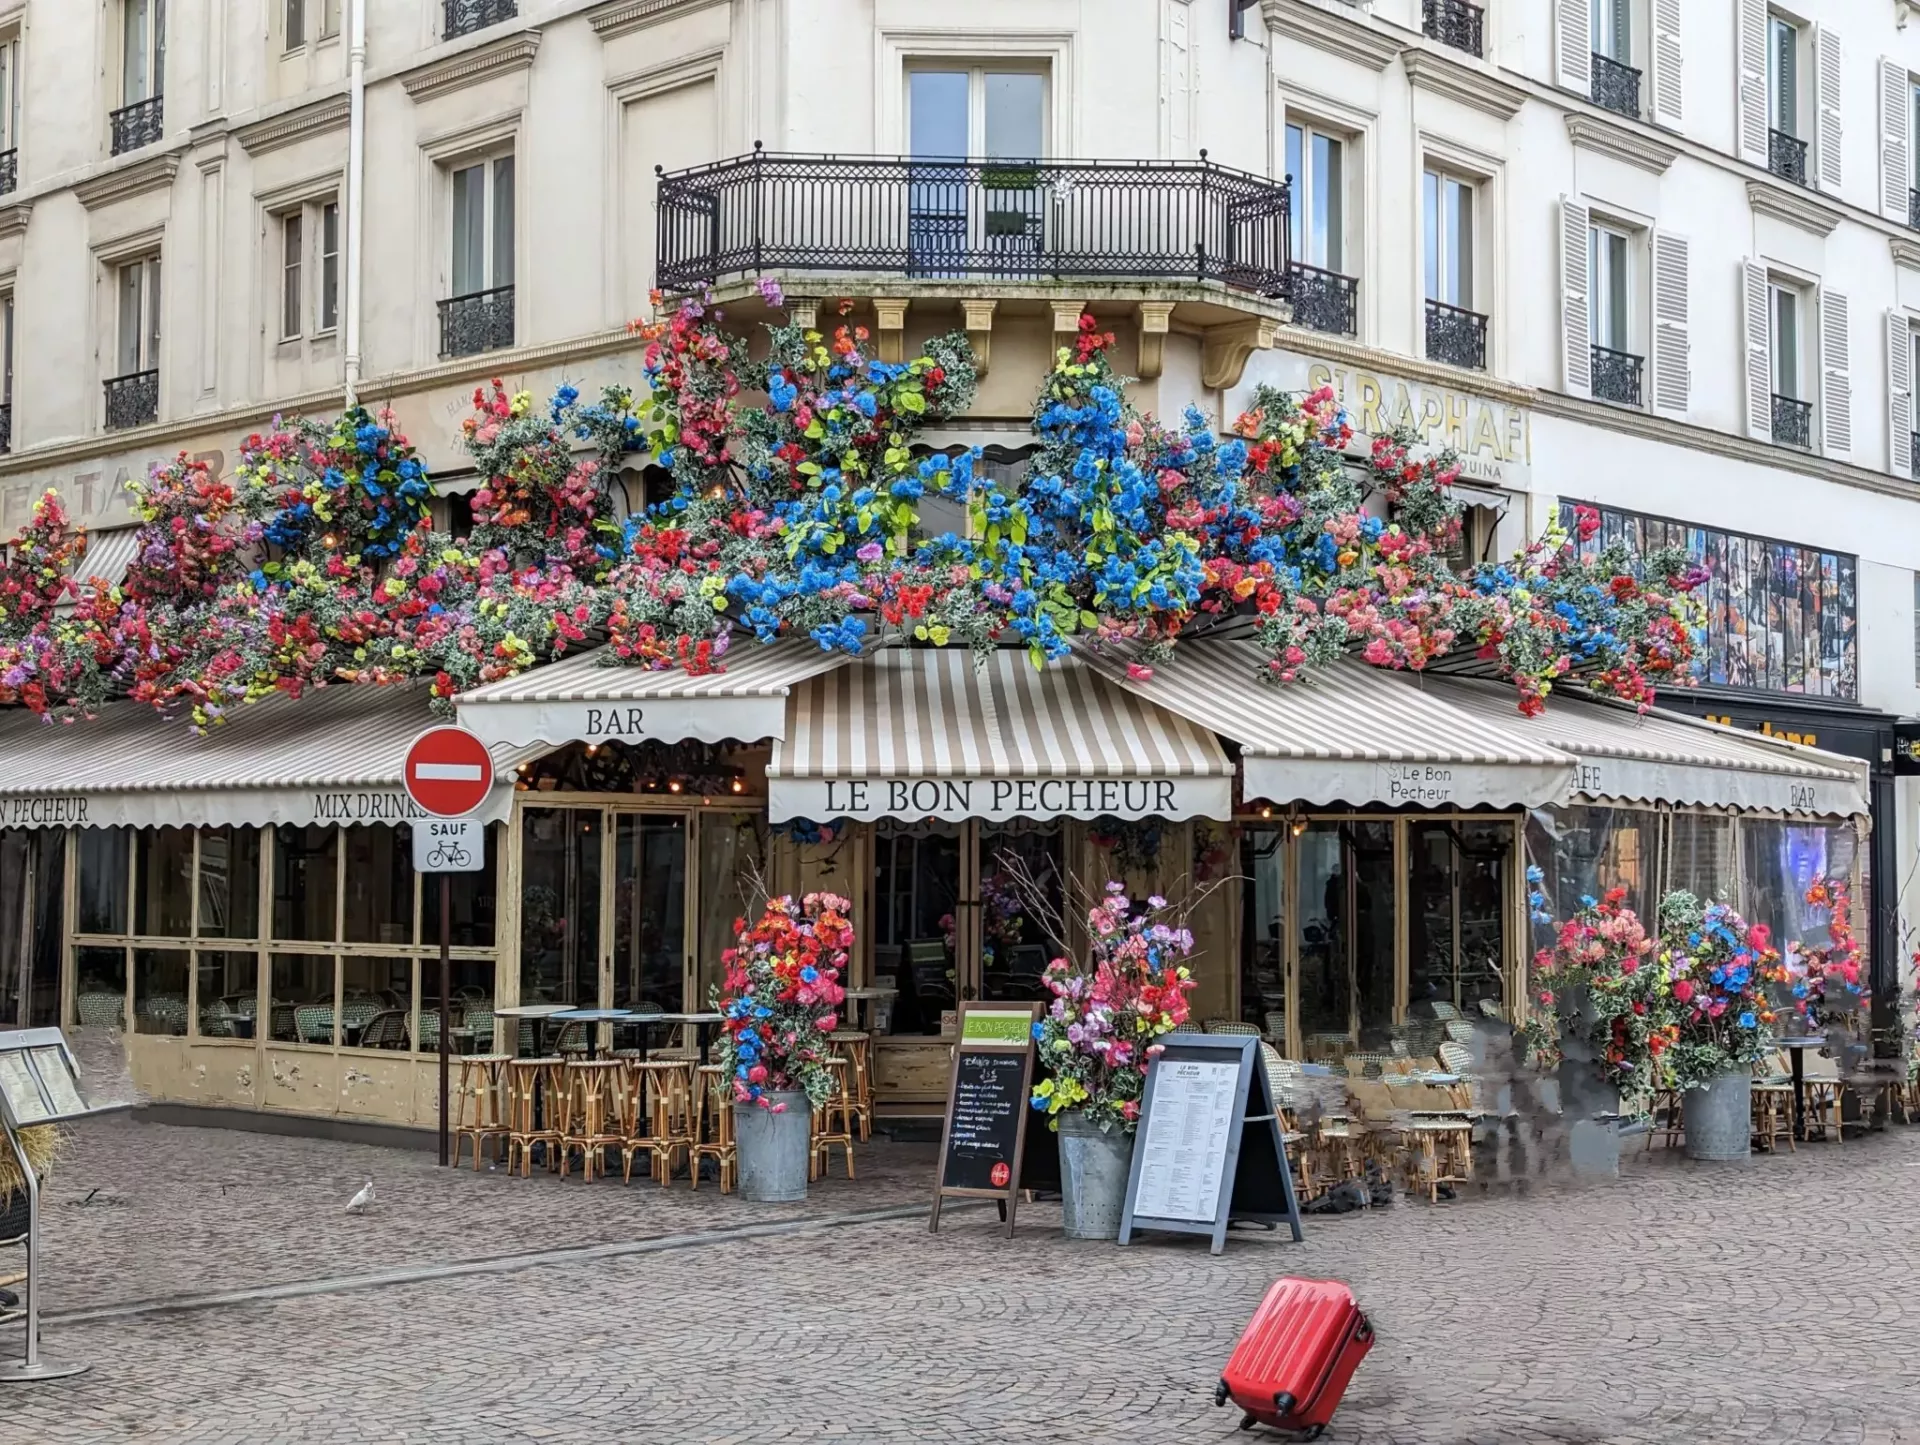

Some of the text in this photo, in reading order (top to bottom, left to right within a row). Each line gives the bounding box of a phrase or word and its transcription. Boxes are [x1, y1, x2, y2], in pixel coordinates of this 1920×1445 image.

[586, 709, 644, 735] BAR
[1402, 766, 1451, 781] Le Bon
[825, 780, 1178, 812] LE BON PECHEUR
[1391, 780, 1451, 800] Pecheur
[1790, 784, 1816, 808] BAR
[13, 797, 88, 823] PECHEUR
[314, 794, 352, 818] MIX
[430, 823, 467, 836] SAUF
